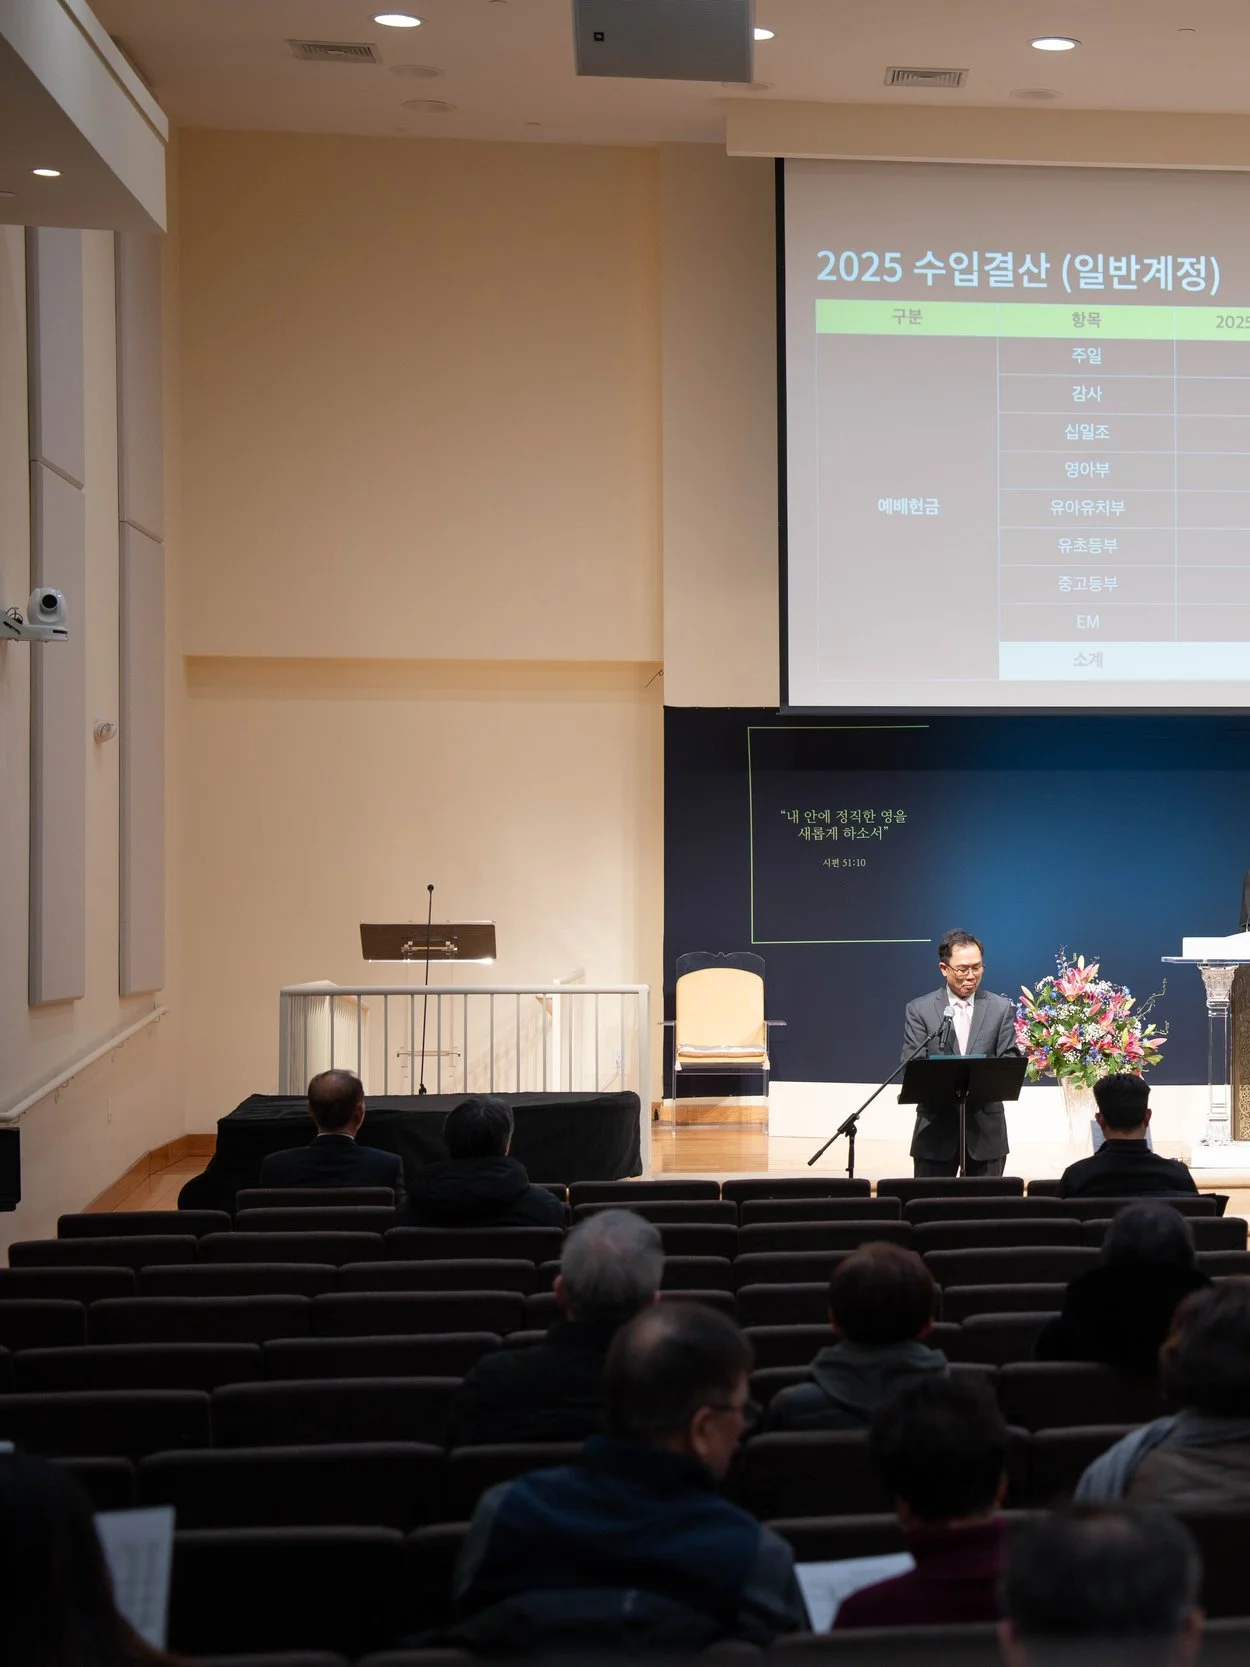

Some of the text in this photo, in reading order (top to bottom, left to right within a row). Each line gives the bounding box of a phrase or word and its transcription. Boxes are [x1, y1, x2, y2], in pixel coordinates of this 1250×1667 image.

[817, 250, 1220, 296] 2025 수입결산 (일반계정)
[892, 308, 923, 325] 구분
[1071, 311, 1101, 329] 항목
[1071, 347, 1102, 365] 주일
[1072, 385, 1103, 402] 감사
[1065, 423, 1110, 440] 십일조
[1065, 461, 1110, 479] 영아부
[878, 497, 940, 515] 예배헌금
[1050, 499, 1126, 516] 유아유치부
[1057, 537, 1118, 554] 유초등부
[1058, 575, 1119, 592] 중고등부
[1077, 615, 1100, 629] EM
[1073, 651, 1103, 669] 소계
[804, 809, 831, 824] 안에
[836, 809, 876, 824] 정직한
[881, 809, 907, 824] 영을
[798, 826, 838, 841] 새롭게
[823, 858, 866, 868] 시편 51:10
